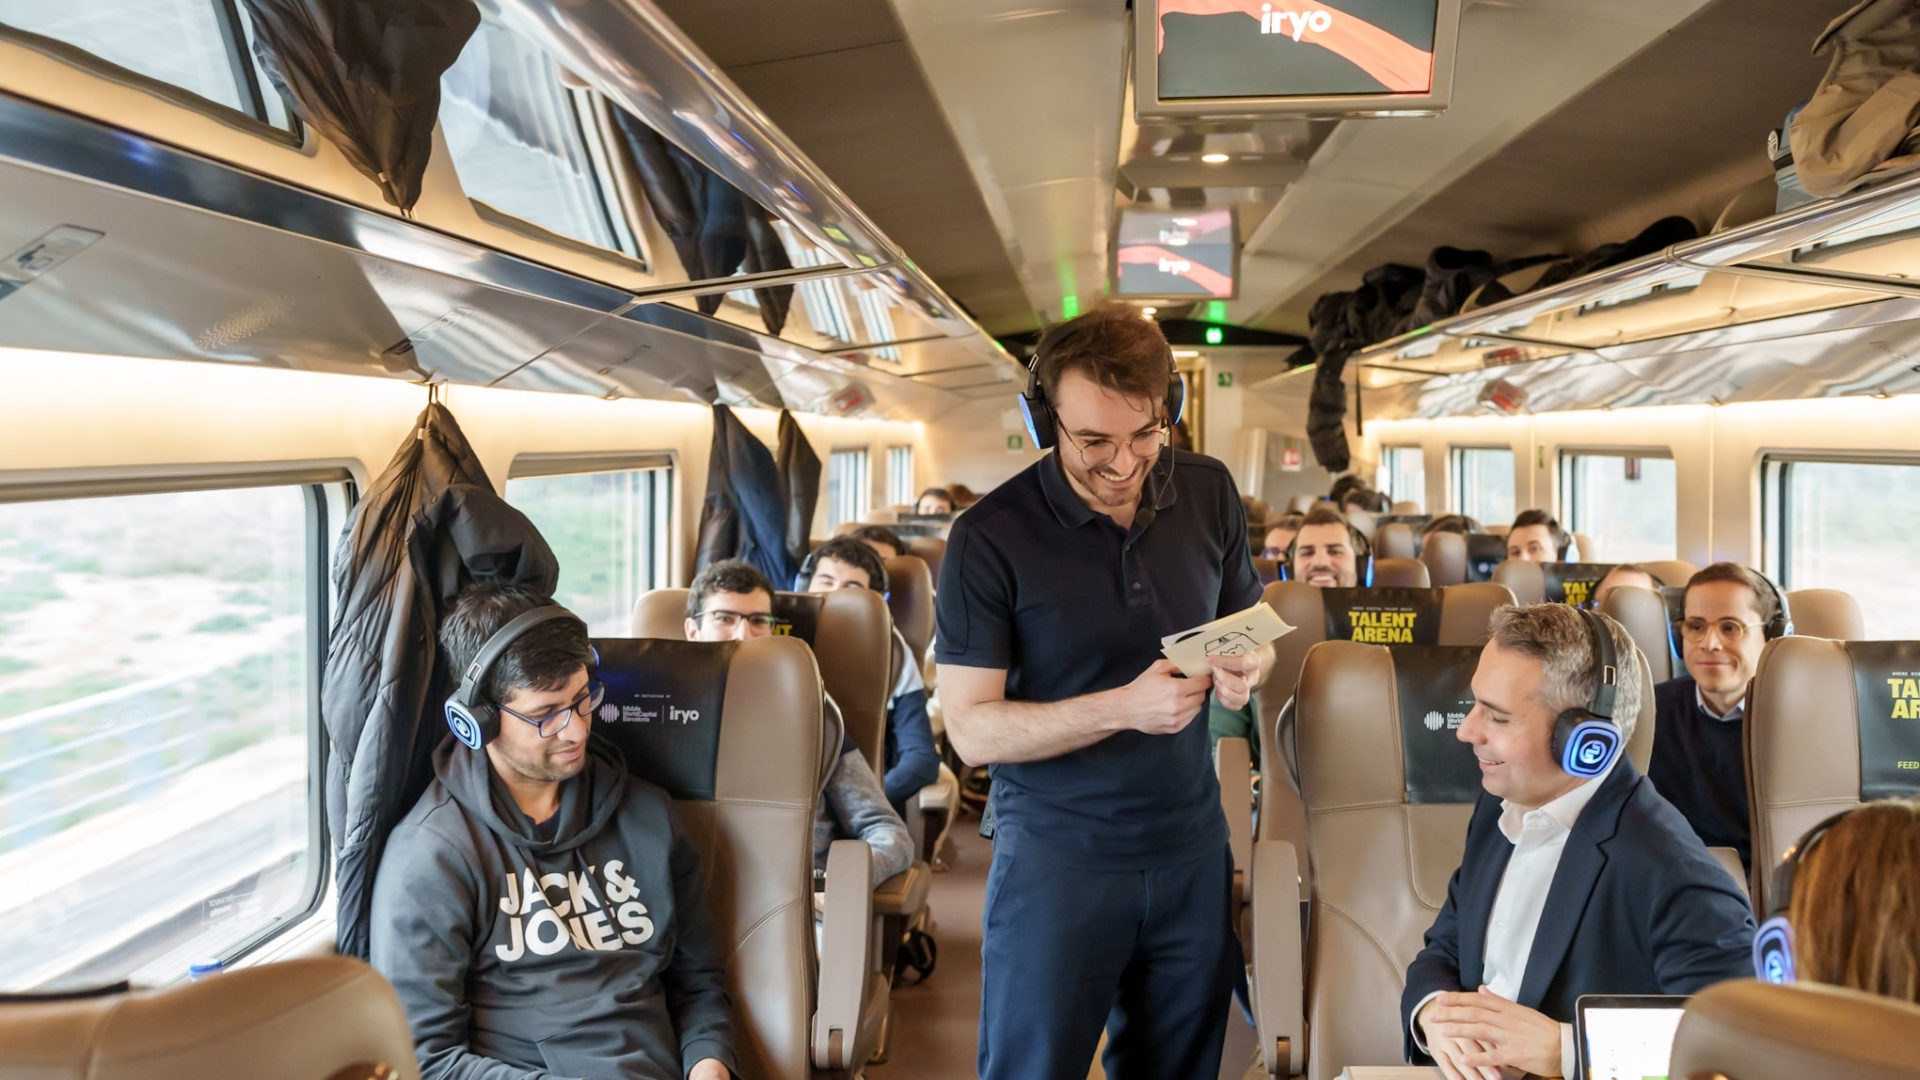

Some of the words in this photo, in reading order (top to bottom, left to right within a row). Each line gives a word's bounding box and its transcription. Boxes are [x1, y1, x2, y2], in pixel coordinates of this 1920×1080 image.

[1260, 3, 1332, 42] iryo
[1348, 611, 1417, 628] TALENT
[1351, 627, 1413, 643] ARENA
[669, 705, 699, 725] iryo
[1897, 761, 1920, 769] FEED
[500, 865, 601, 918] JACK
[603, 859, 641, 903] &
[495, 900, 655, 962] JONES
